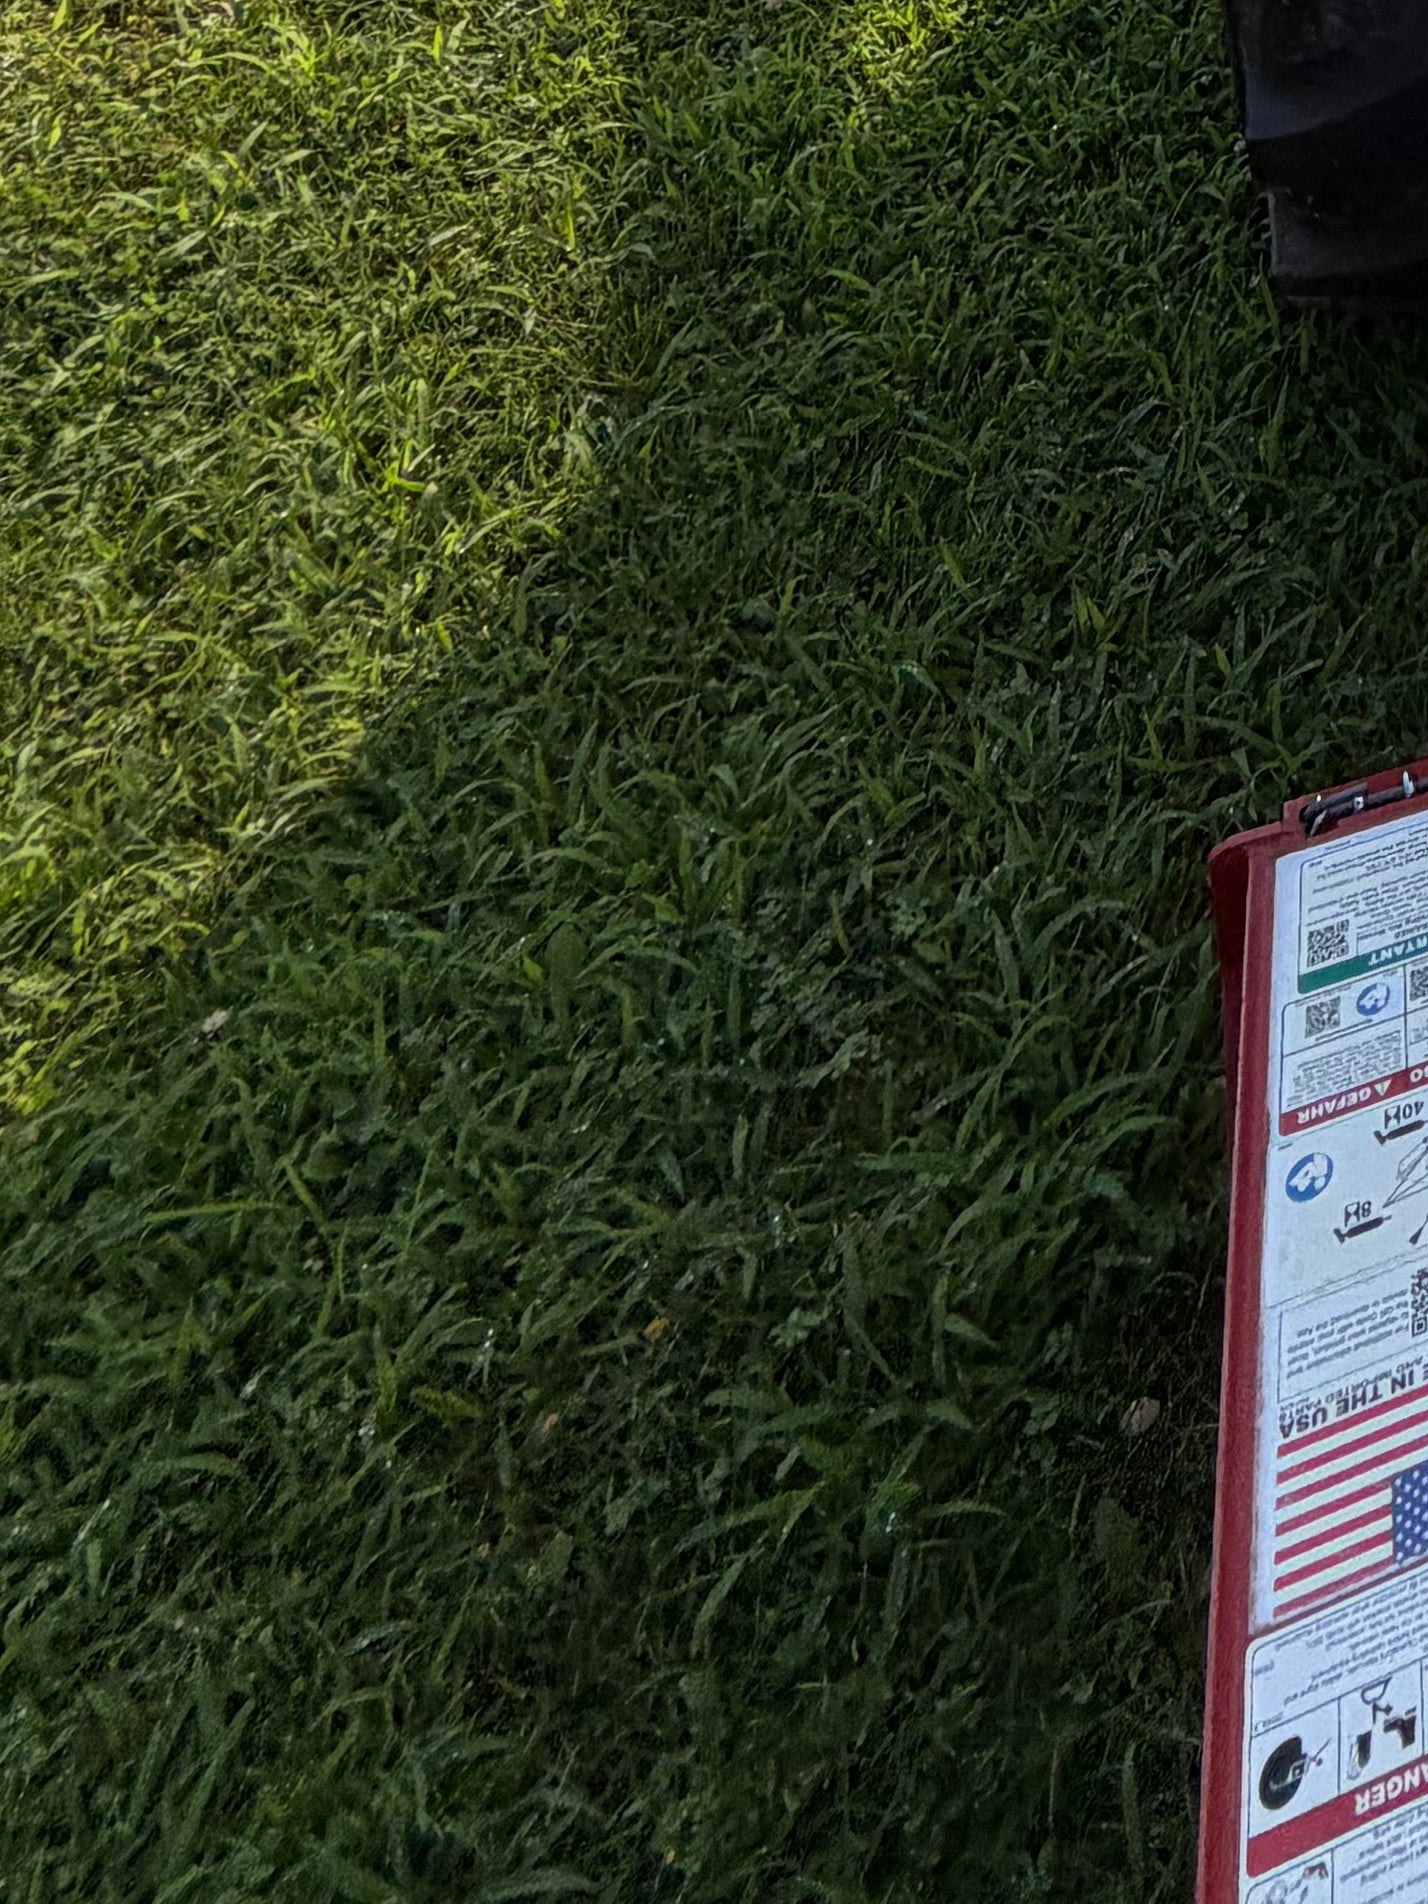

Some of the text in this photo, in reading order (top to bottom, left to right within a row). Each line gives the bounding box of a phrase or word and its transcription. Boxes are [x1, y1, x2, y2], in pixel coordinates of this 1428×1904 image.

[1297, 1085, 1370, 1125] GEFAHR
[1401, 1097, 1424, 1120] 40
[1359, 1198, 1371, 1218] 8
[1390, 1369, 1413, 1394] IN
[1335, 1382, 1381, 1417] THE
[1278, 1405, 1327, 1441] USA
